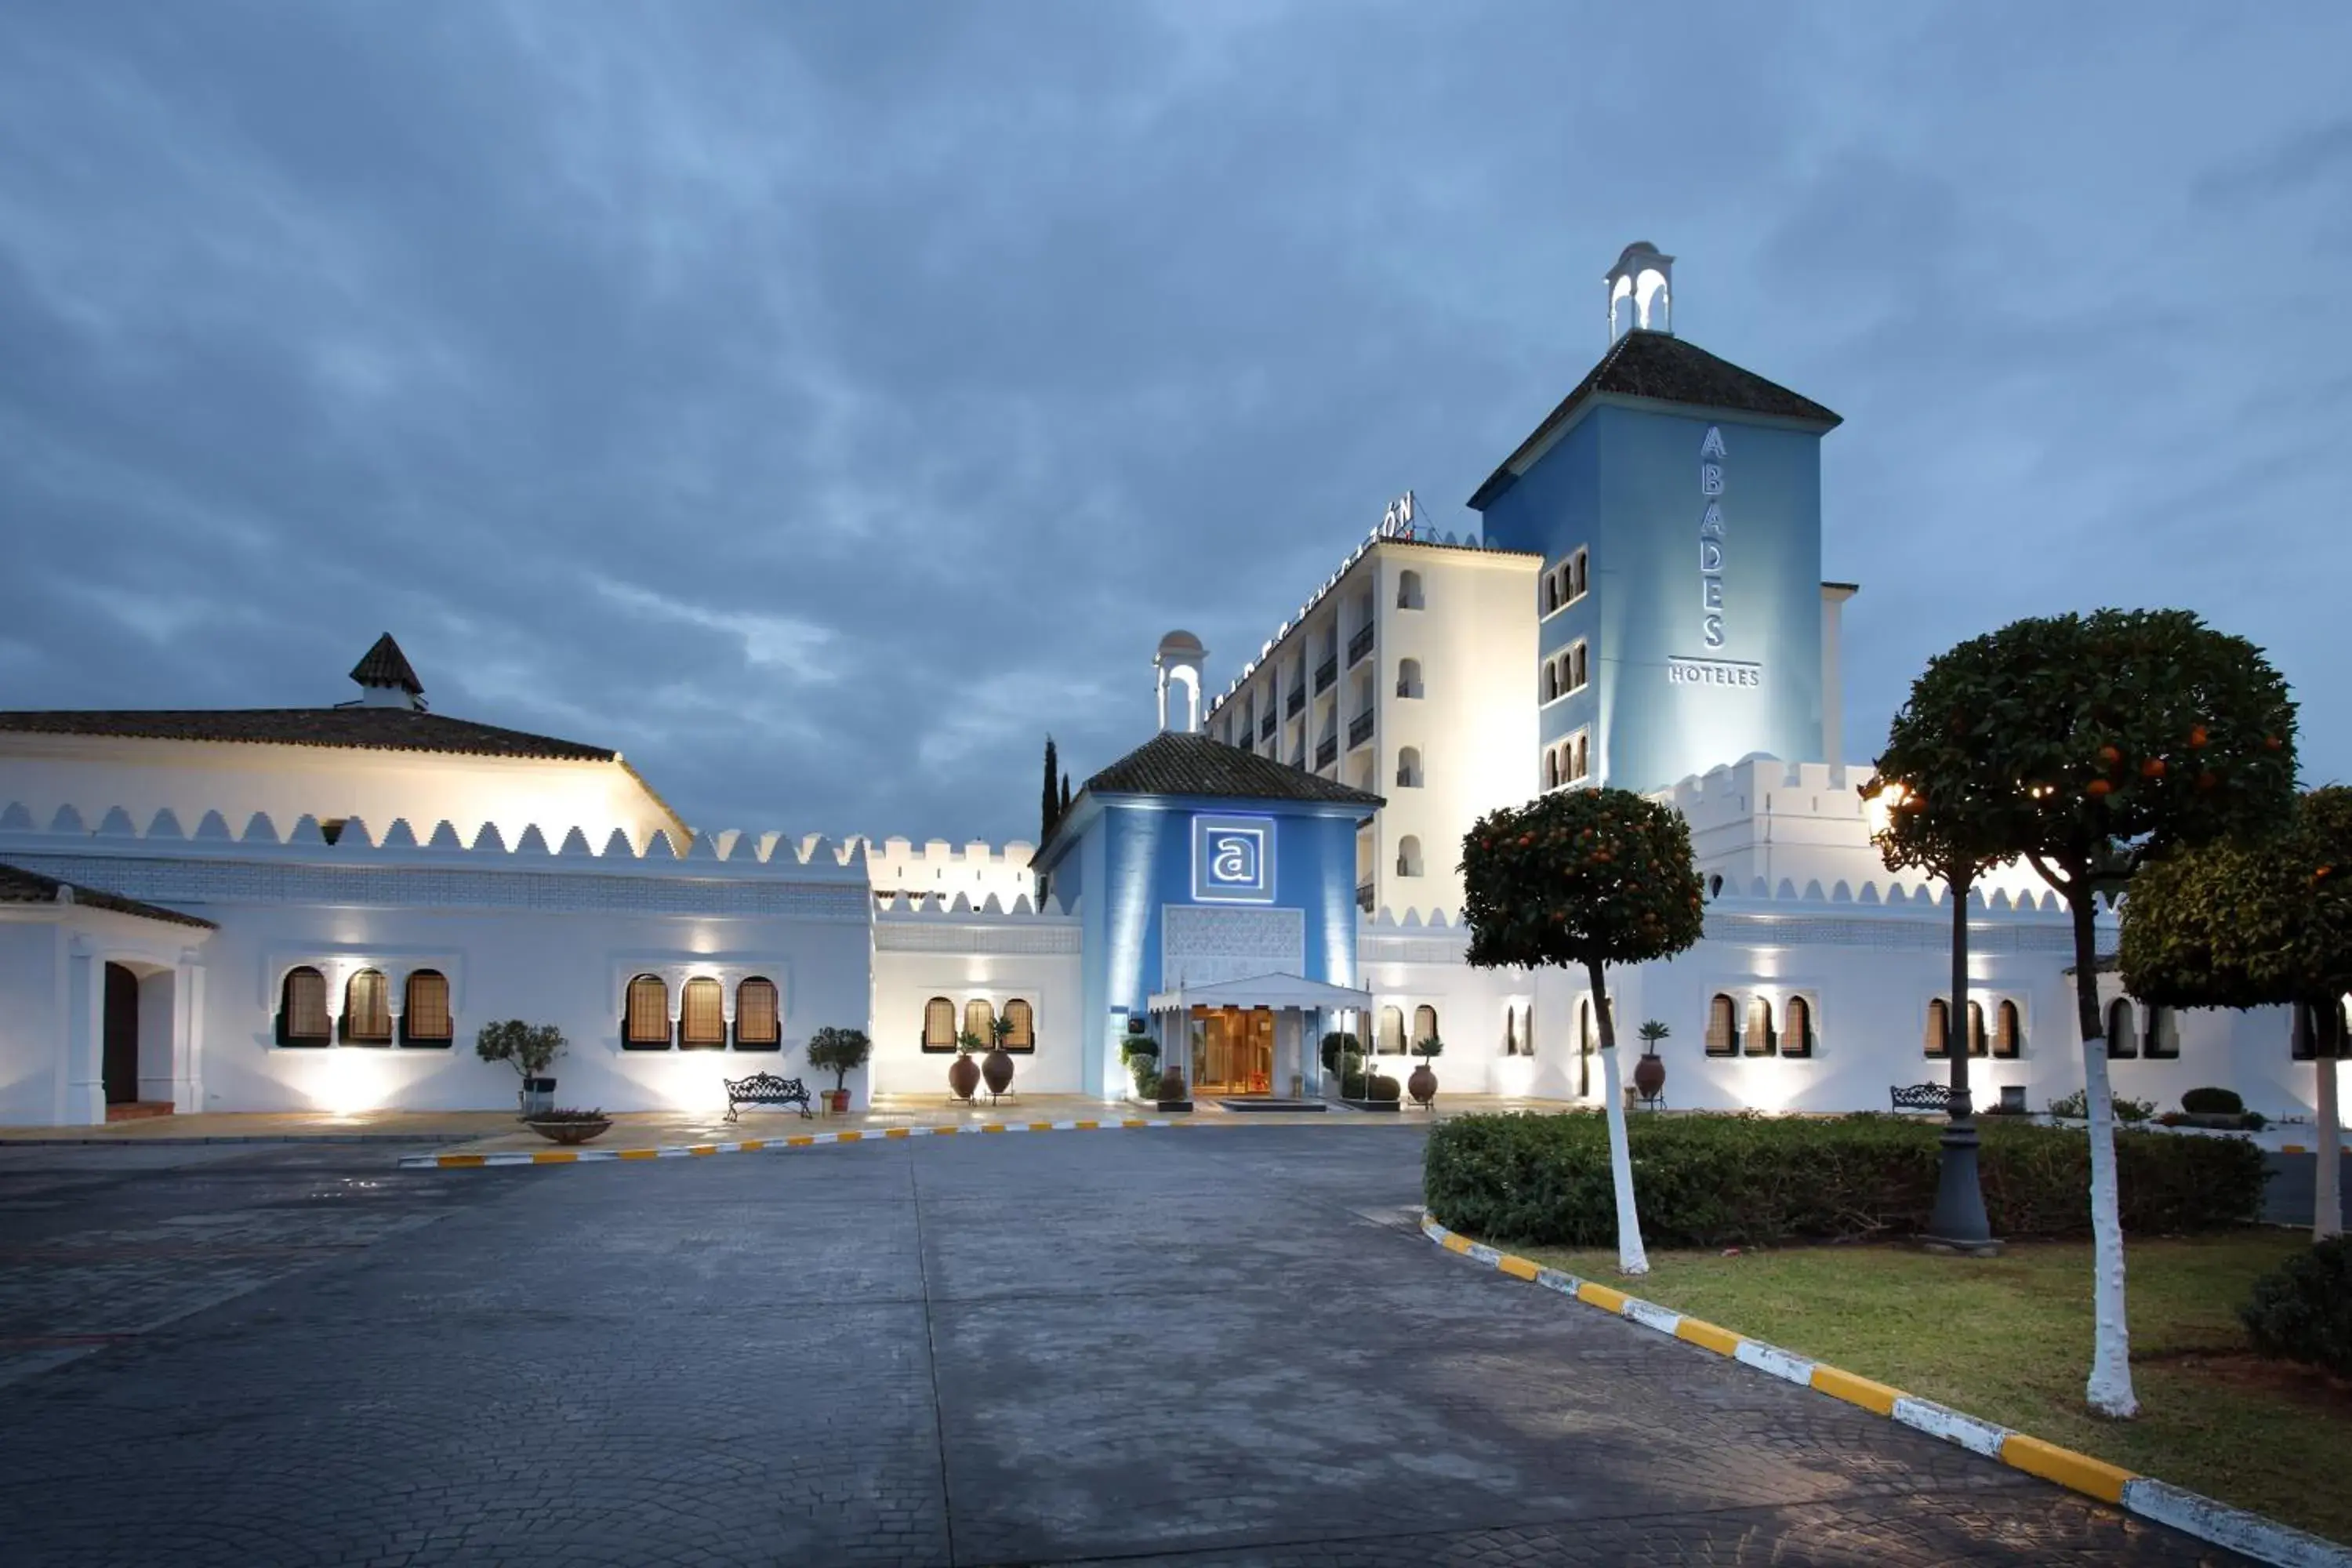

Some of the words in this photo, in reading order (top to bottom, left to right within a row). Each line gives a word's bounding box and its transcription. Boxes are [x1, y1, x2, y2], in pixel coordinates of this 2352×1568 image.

[1700, 426, 1727, 649] ABADES
[1669, 665, 1761, 688] HOTELES
[1214, 837, 1255, 881] a
